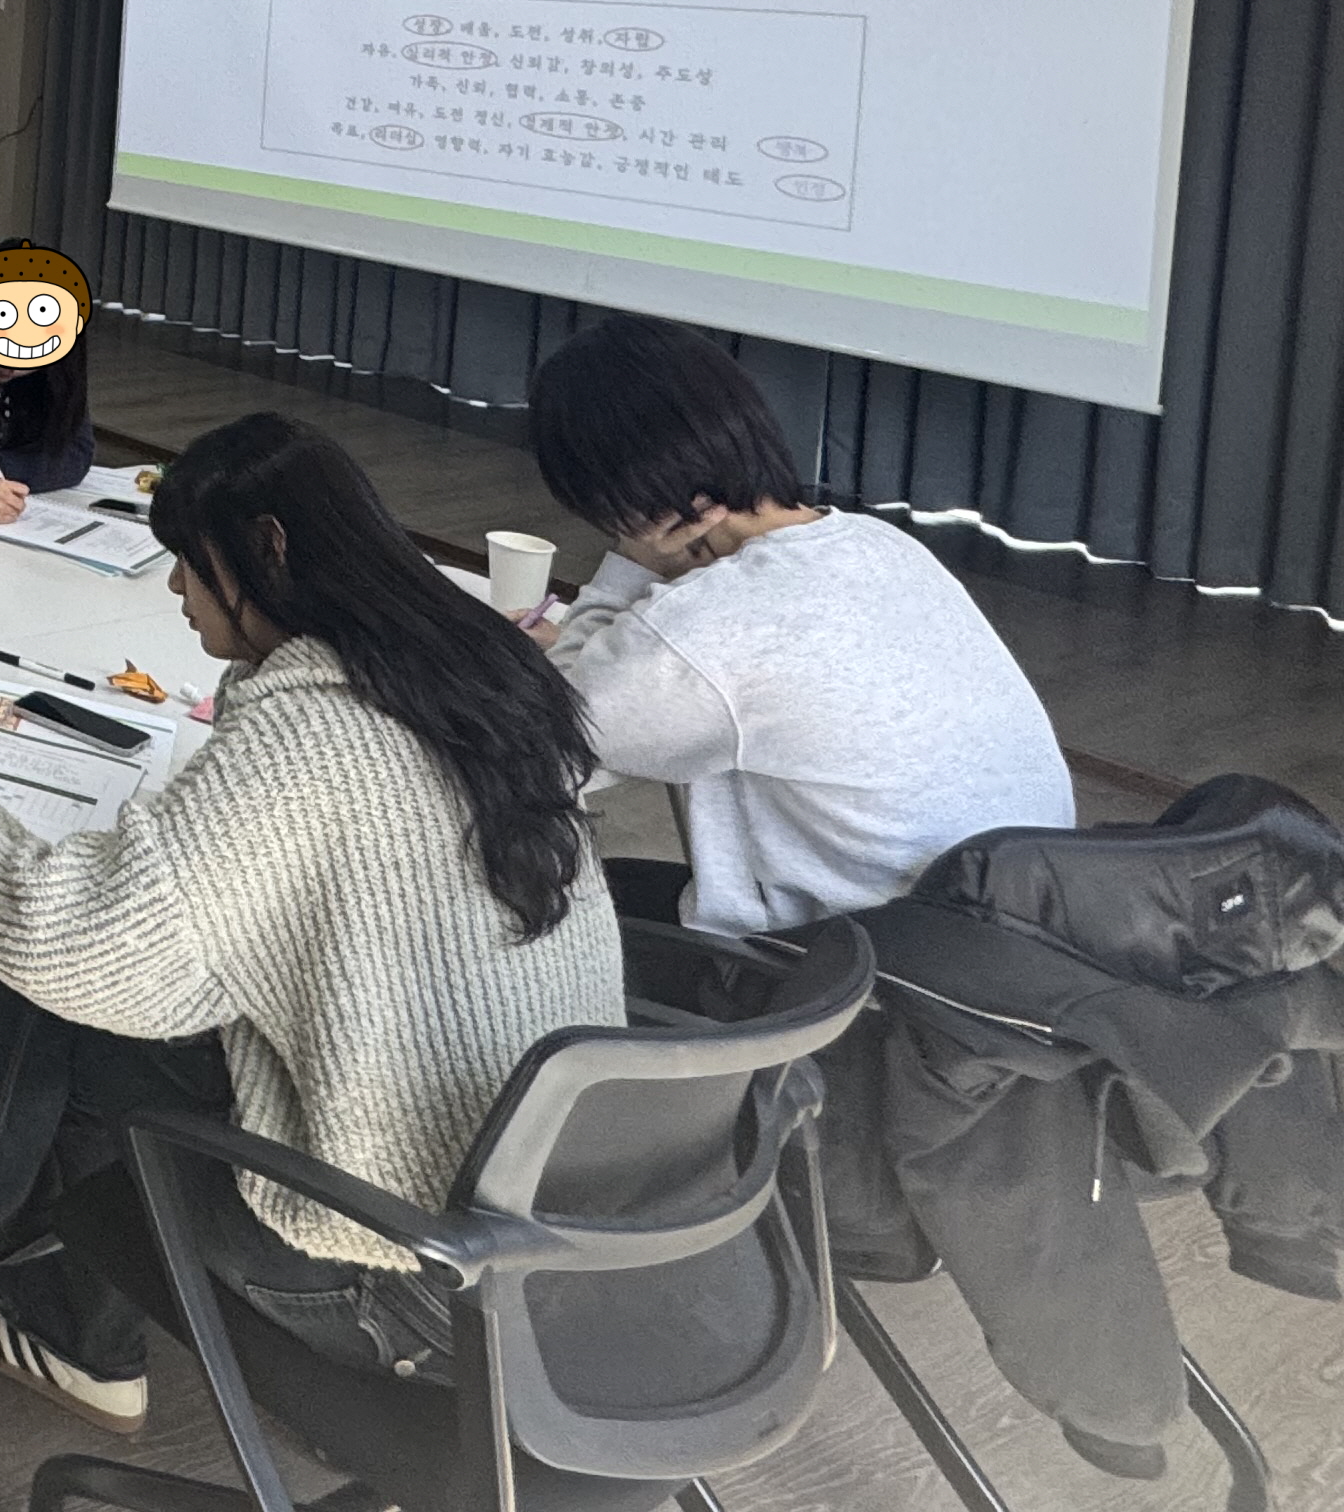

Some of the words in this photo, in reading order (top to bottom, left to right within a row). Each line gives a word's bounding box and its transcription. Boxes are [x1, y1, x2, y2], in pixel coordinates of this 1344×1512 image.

[509, 24, 550, 43] 도전,
[560, 26, 603, 46] 성취,
[613, 29, 650, 49] 자립
[361, 41, 398, 59] 자유,
[510, 53, 569, 75] 신뢰감,
[580, 58, 643, 80] 창의성,
[655, 64, 713, 86] 주도성
[410, 73, 447, 93] 가족,
[456, 78, 494, 98] 신뢰,
[608, 92, 646, 112] 존중
[344, 95, 380, 114] 건강,
[432, 105, 464, 123] 도전
[638, 125, 677, 148] 시간
[688, 131, 729, 152] 관리
[497, 142, 530, 162] 자기
[613, 155, 690, 182] 긍정적인
[702, 166, 745, 186] 태도
